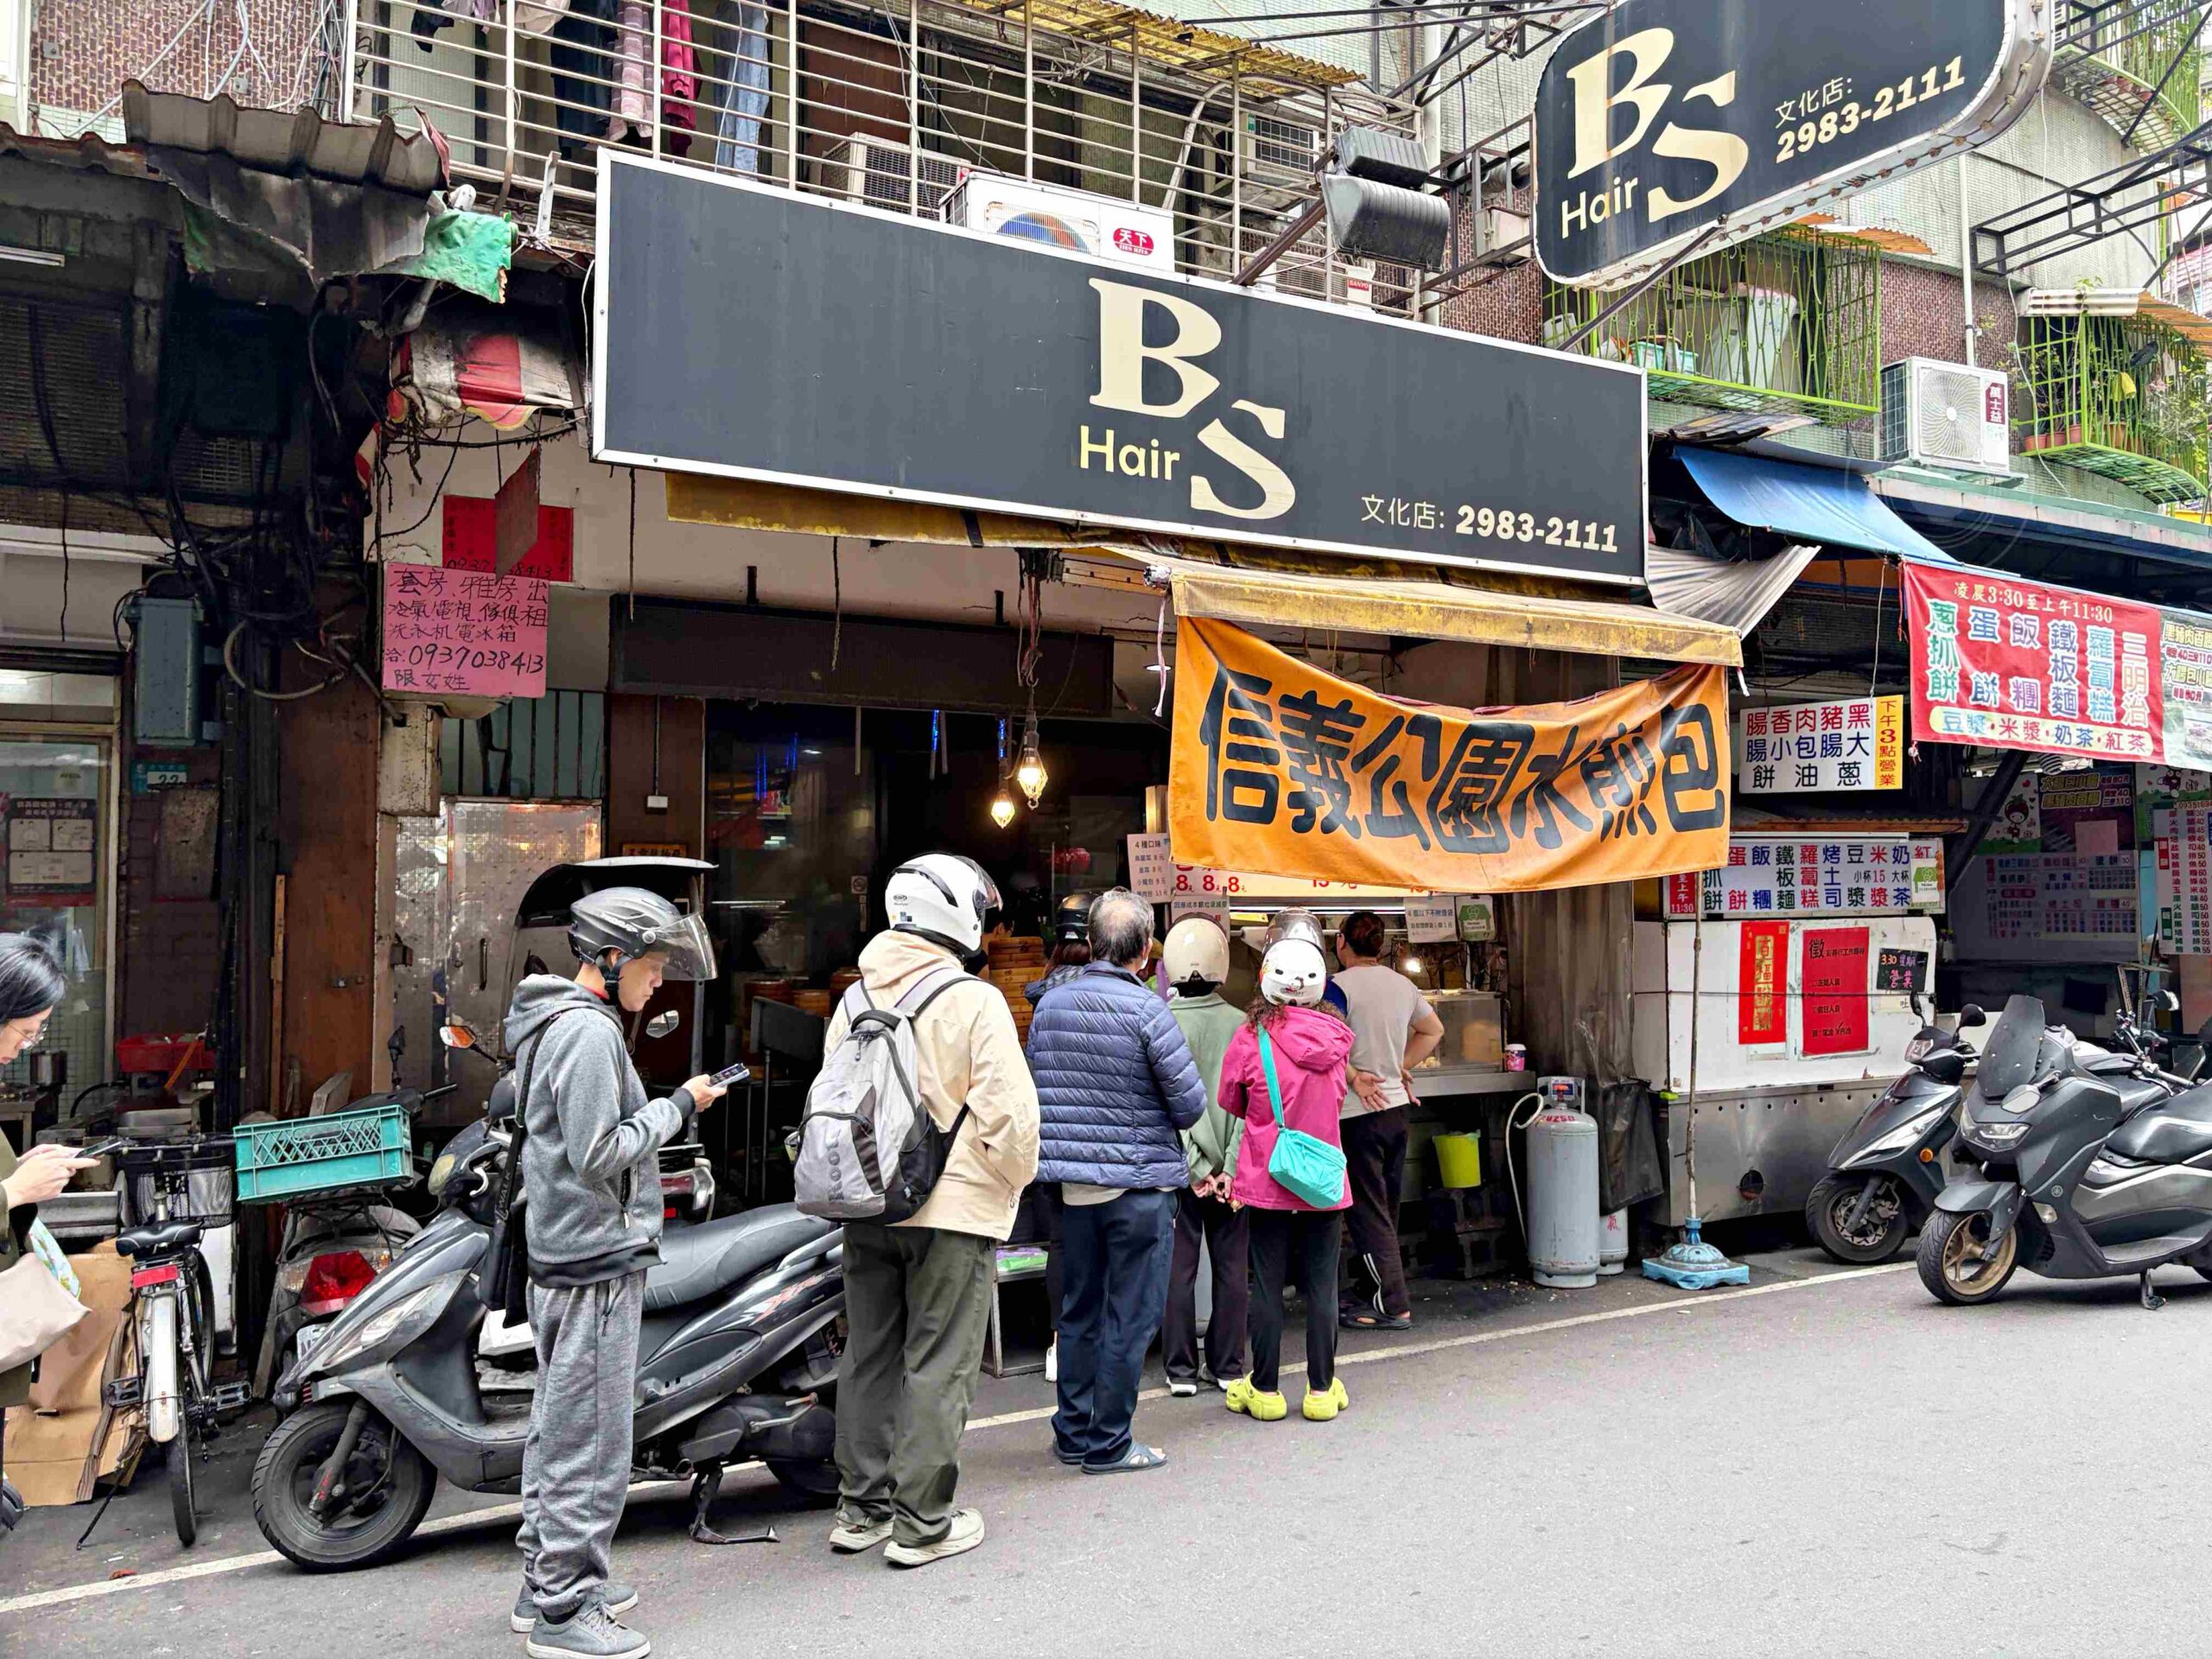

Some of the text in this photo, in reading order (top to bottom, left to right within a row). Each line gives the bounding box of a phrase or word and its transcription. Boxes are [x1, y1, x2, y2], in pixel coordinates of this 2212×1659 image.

[1775, 76, 1853, 129] 文化店:
[1776, 55, 1966, 164] 2983-2111
[1119, 228, 1148, 247] 天下
[1561, 176, 1638, 238] Hair
[1080, 425, 1180, 480] Hair
[1361, 494, 1618, 553] 文化店: 2983-2111
[1926, 601, 1959, 702] 蔥抓餅
[2050, 621, 2078, 717] 鐵板麵
[2123, 632, 2148, 728] 三明治
[1200, 665, 1726, 854] 信義公園水煎包
[1879, 700, 1897, 785] 下午3點營業
[1822, 844, 1841, 907] 烤土司
